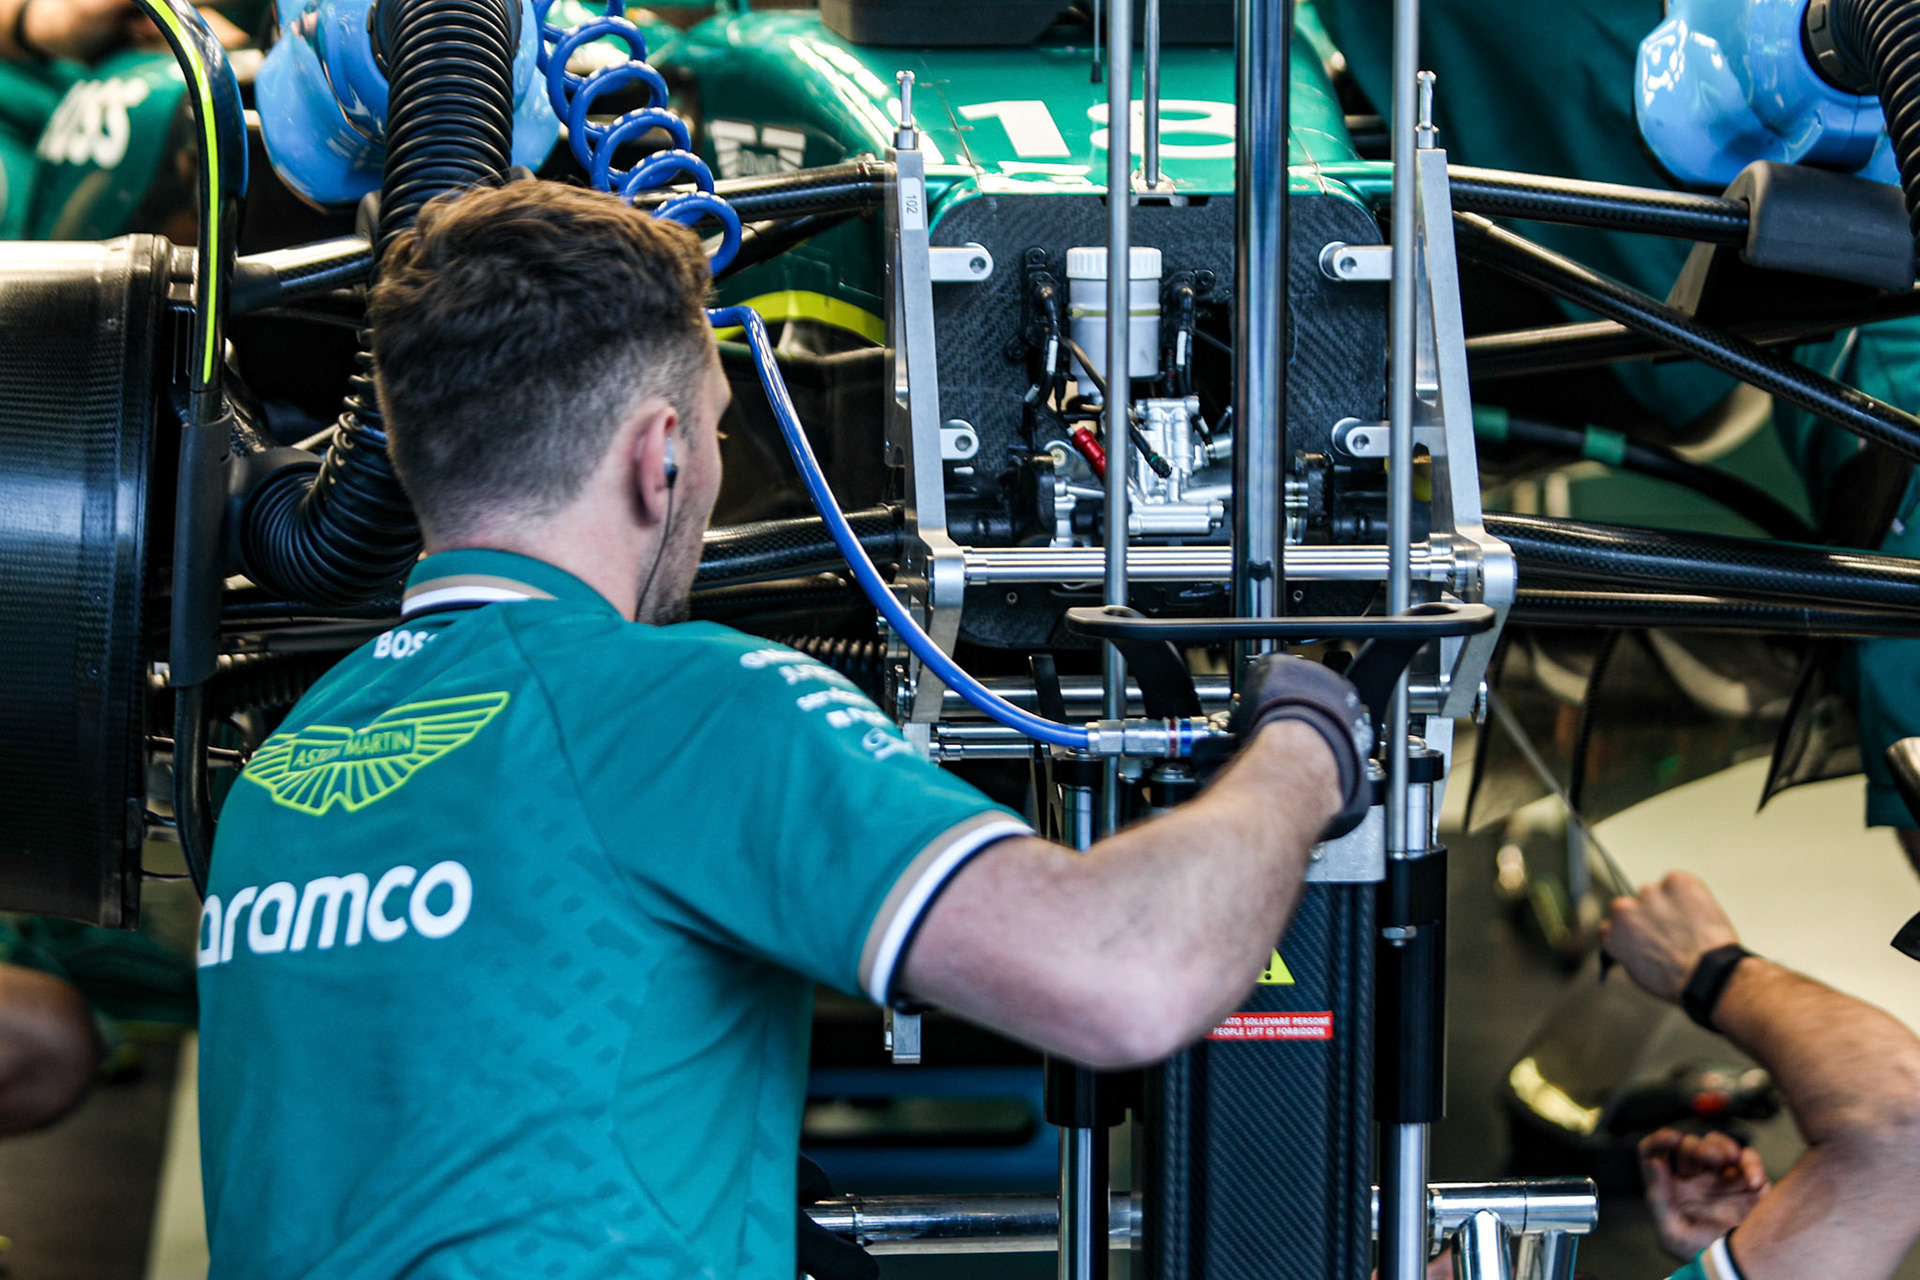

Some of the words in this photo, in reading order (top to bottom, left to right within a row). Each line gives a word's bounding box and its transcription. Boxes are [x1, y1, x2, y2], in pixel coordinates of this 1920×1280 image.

[957, 98, 1290, 160] 18
[906, 195, 919, 214] 102
[342, 728, 413, 757] MARTIN
[197, 860, 473, 968] aramco
[1212, 1027, 1245, 1036] PEOPLE
[1246, 1027, 1264, 1036] LIFT
[1265, 1027, 1275, 1036] IS
[1276, 1027, 1325, 1036] FORBIDDEN
[1222, 1017, 1241, 1026] ATO
[1243, 1016, 1290, 1026] SOLLEVARE
[1292, 1016, 1330, 1026] PERSONE
